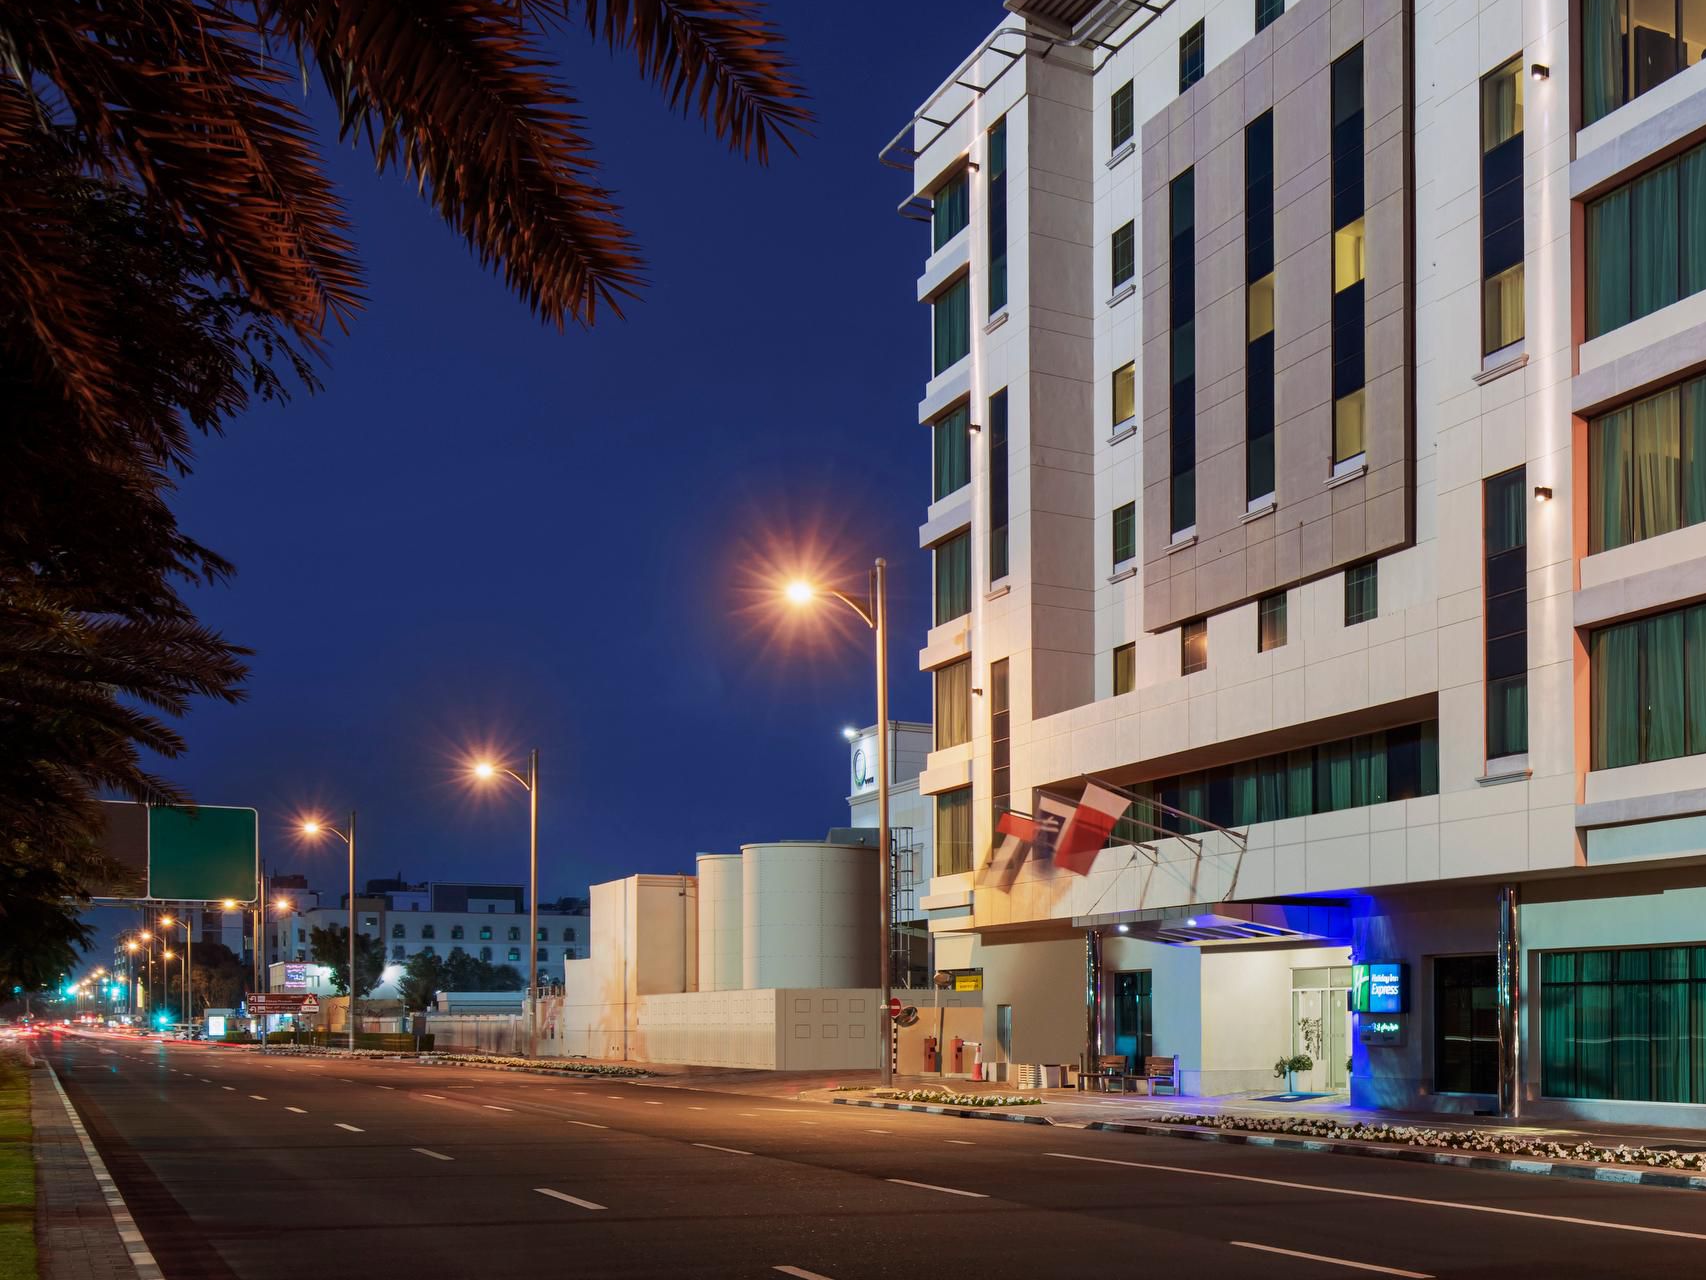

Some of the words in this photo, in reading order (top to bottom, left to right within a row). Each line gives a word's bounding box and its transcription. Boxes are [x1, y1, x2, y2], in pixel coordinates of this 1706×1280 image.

[1371, 973, 1390, 984] Holiday
[1390, 973, 1399, 982] Inn
[1371, 983, 1399, 998] Express
